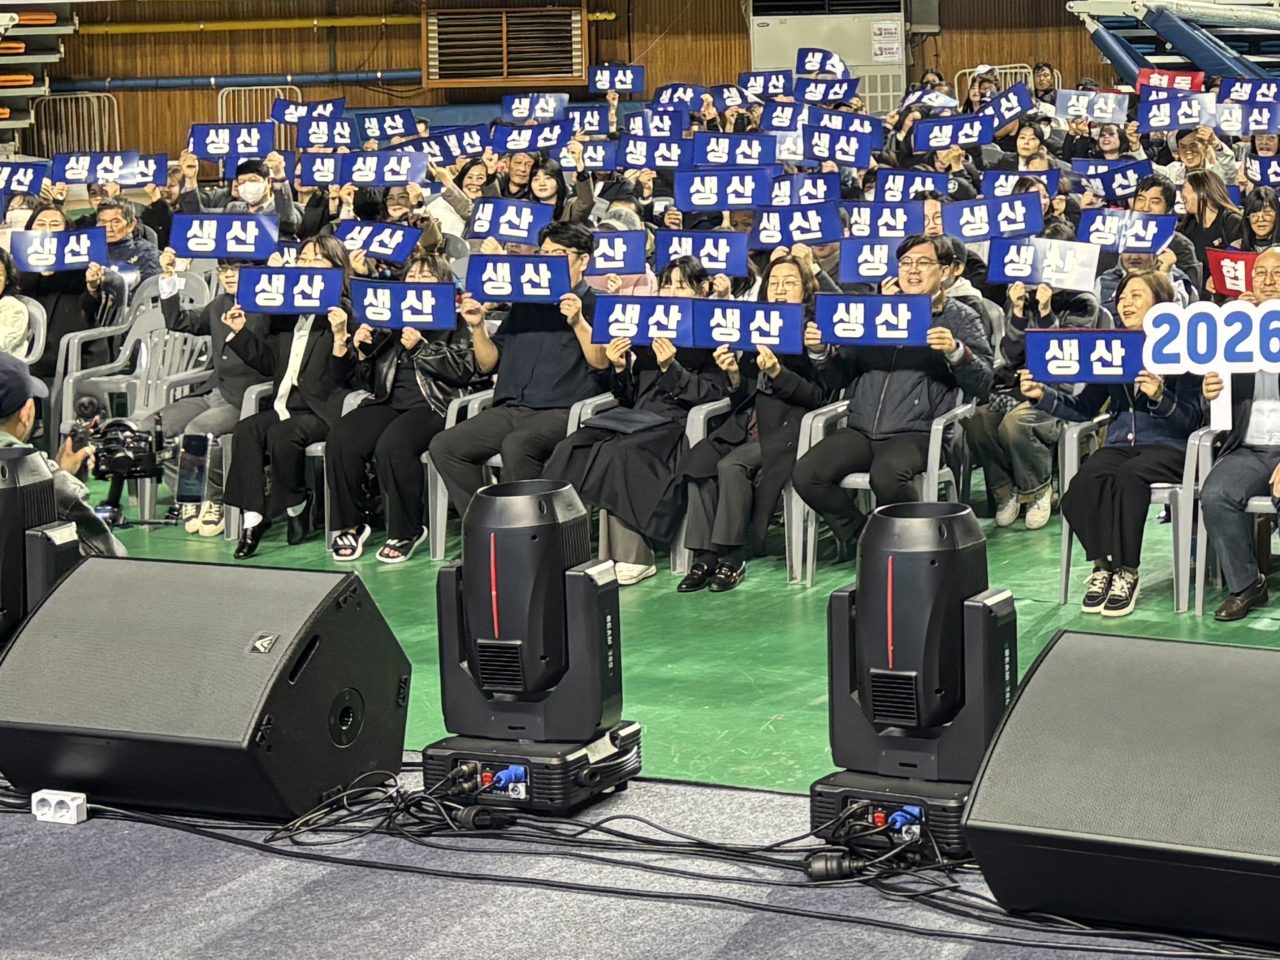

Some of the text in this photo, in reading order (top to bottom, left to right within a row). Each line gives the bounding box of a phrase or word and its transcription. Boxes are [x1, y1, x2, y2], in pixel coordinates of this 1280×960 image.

[313, 158, 335, 182] 생
[858, 244, 889, 276] 생
[1221, 259, 1246, 291] 협
[1045, 340, 1125, 376] 생산
